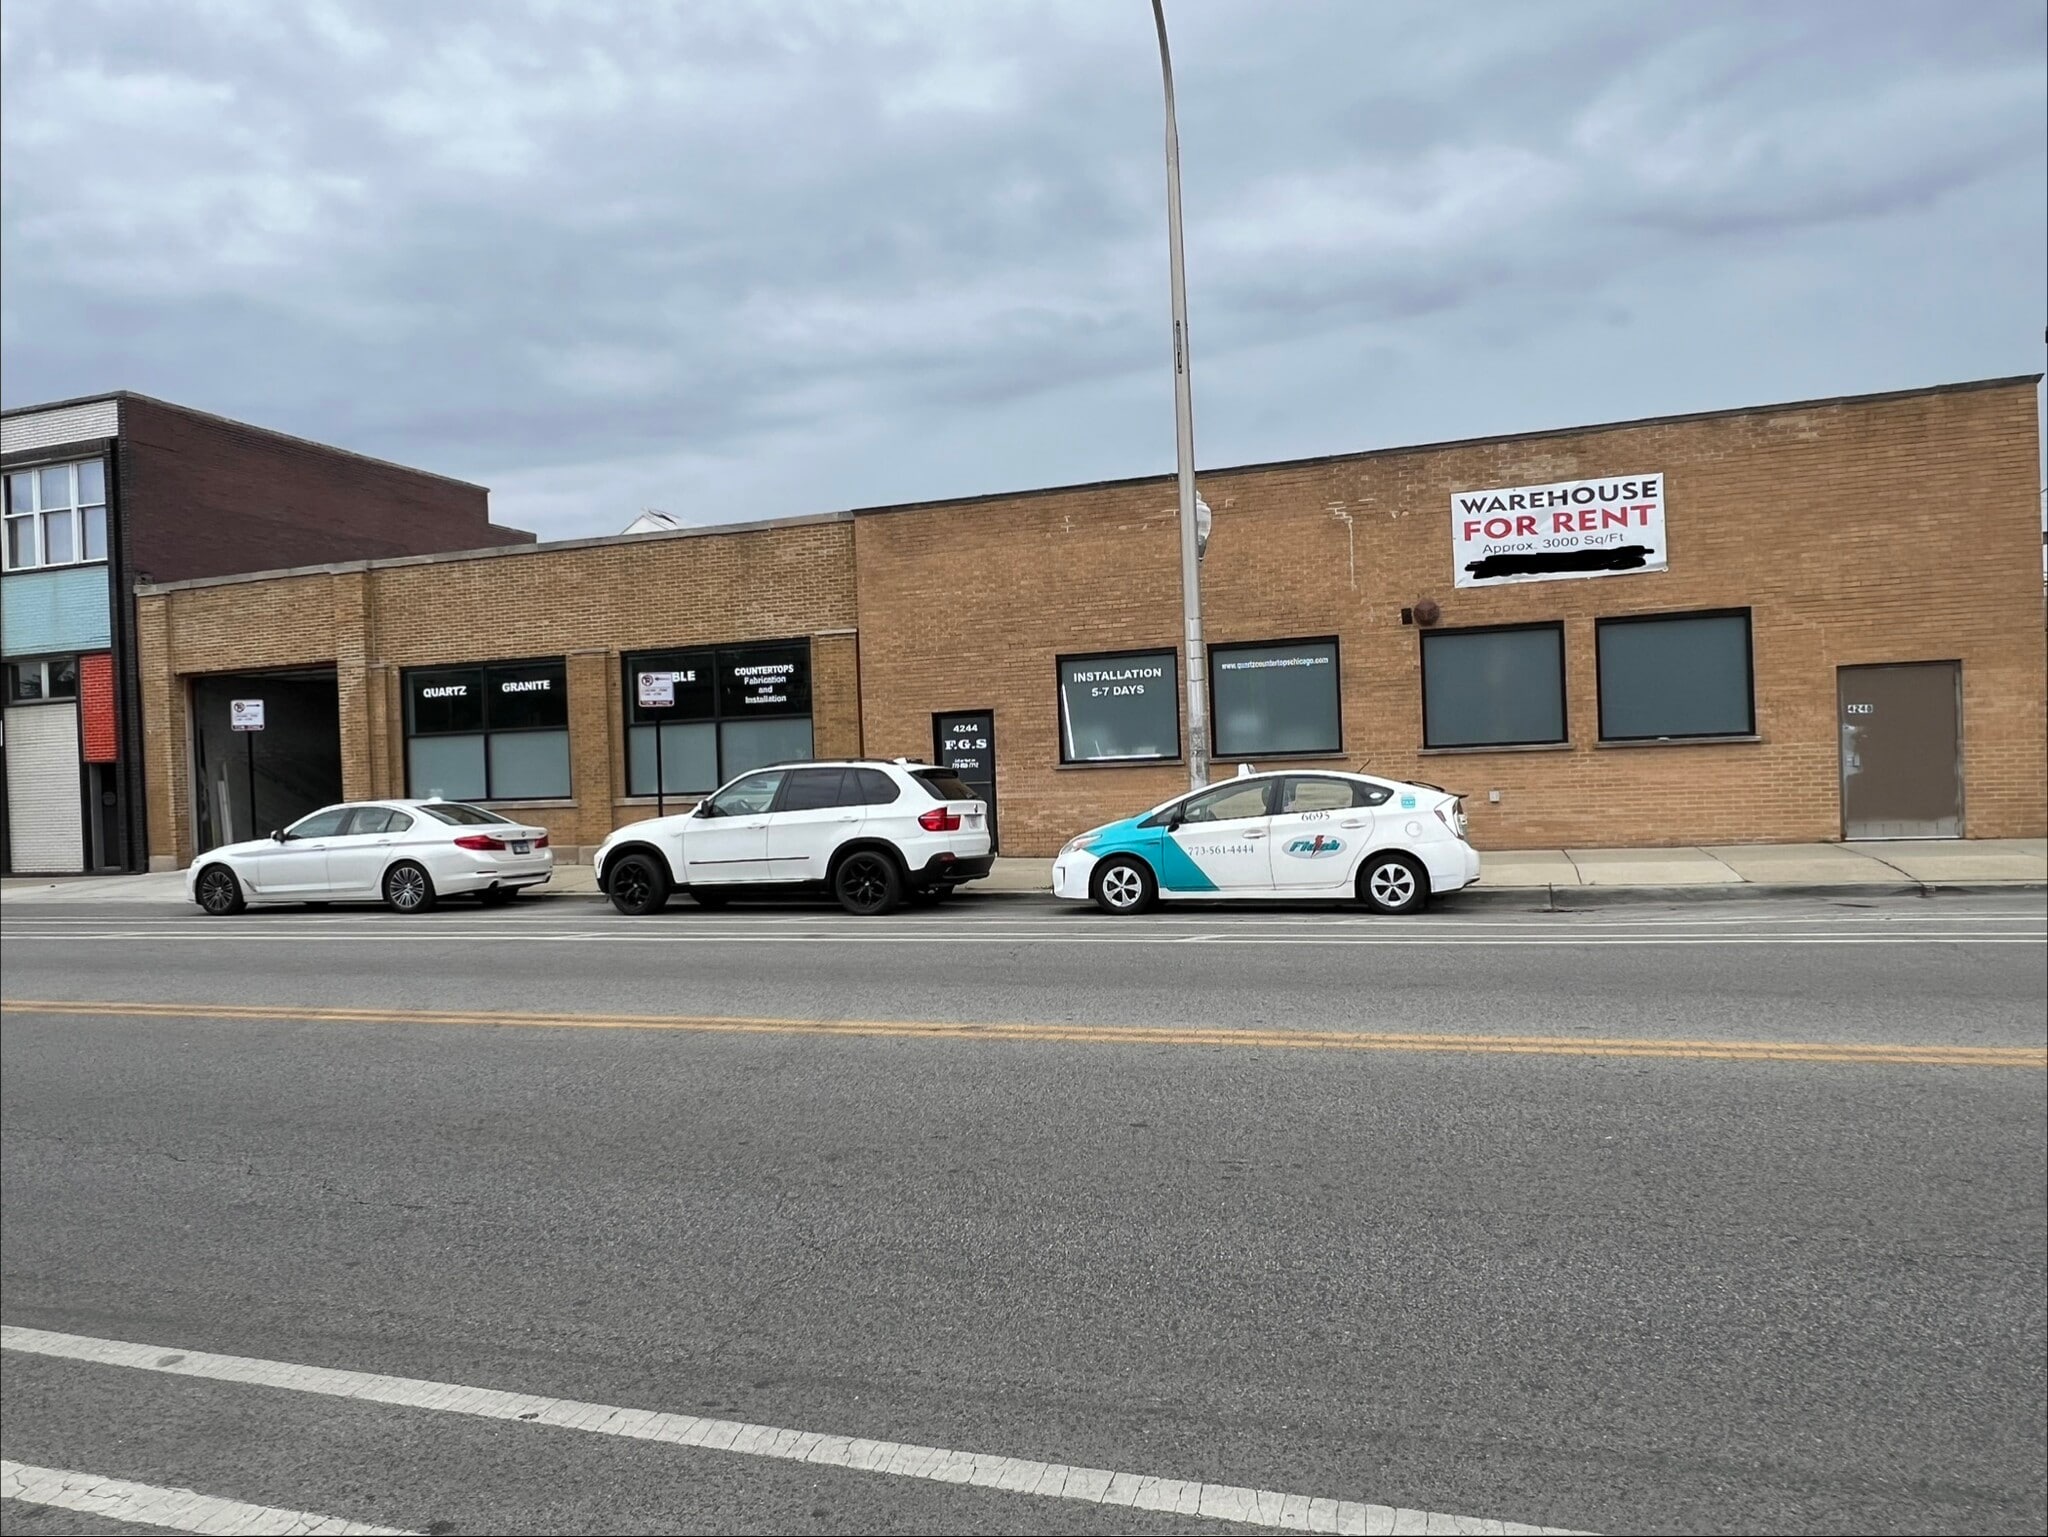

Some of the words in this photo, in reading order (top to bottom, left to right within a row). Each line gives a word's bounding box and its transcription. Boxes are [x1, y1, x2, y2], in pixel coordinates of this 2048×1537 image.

[1460, 480, 1658, 515] WAREHOUSE
[1464, 515, 1538, 541] FOR
[1553, 504, 1656, 533] RENT
[1482, 541, 1538, 555] Approx.
[1543, 536, 1579, 549] 3000
[1584, 533, 1624, 546] Sq/Ft
[734, 664, 795, 676] COUNTERTOPS
[1073, 668, 1162, 682] INSTALLATION
[672, 670, 696, 683] BLE
[744, 675, 787, 685] Fabrication
[423, 686, 467, 698] QUARTZ
[502, 680, 551, 693] GRANITE
[758, 685, 773, 694] and
[1091, 687, 1110, 697] 5-7
[1113, 685, 1145, 696] DAYS
[745, 695, 787, 704] Installation
[953, 724, 978, 733] 4244
[944, 739, 987, 750] F.G.S
[1188, 845, 1254, 856] 773-561-4444
